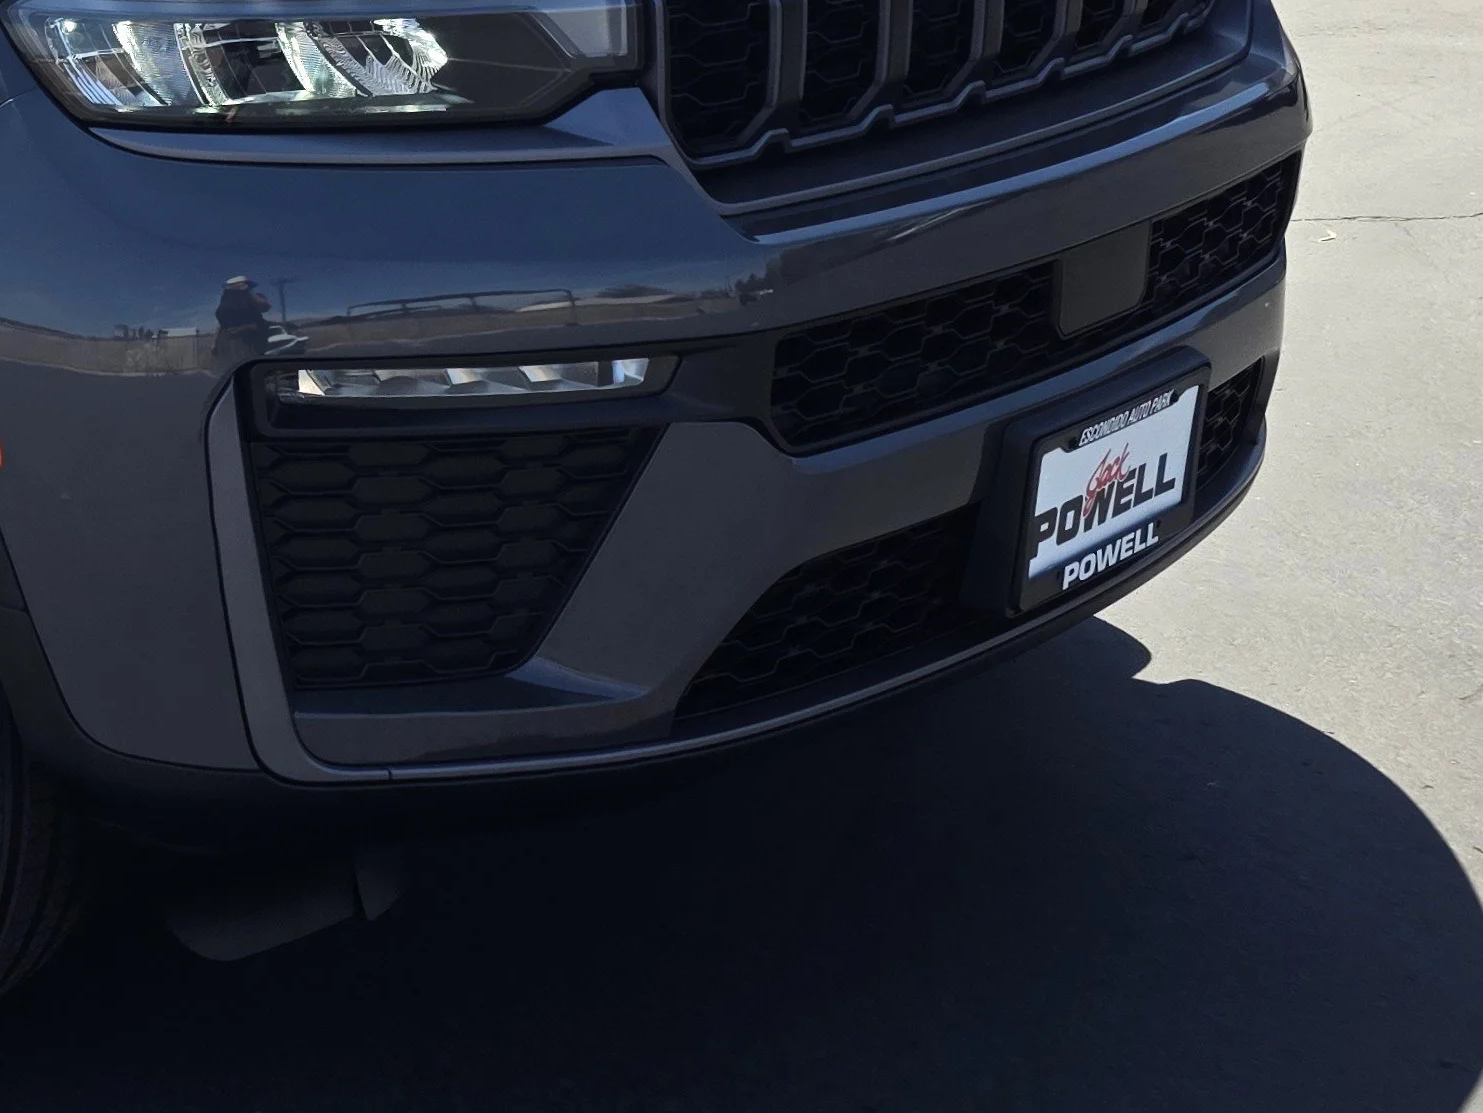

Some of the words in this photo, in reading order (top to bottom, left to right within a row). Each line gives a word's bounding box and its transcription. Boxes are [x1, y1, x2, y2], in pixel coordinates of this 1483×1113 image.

[1078, 410, 1130, 447] ESCONDIDO
[1128, 400, 1153, 426] AUTO
[1150, 389, 1175, 415] PARK
[1032, 452, 1176, 559] POWELL
[1083, 442, 1130, 517] Jack
[1062, 522, 1159, 590] POWELL
